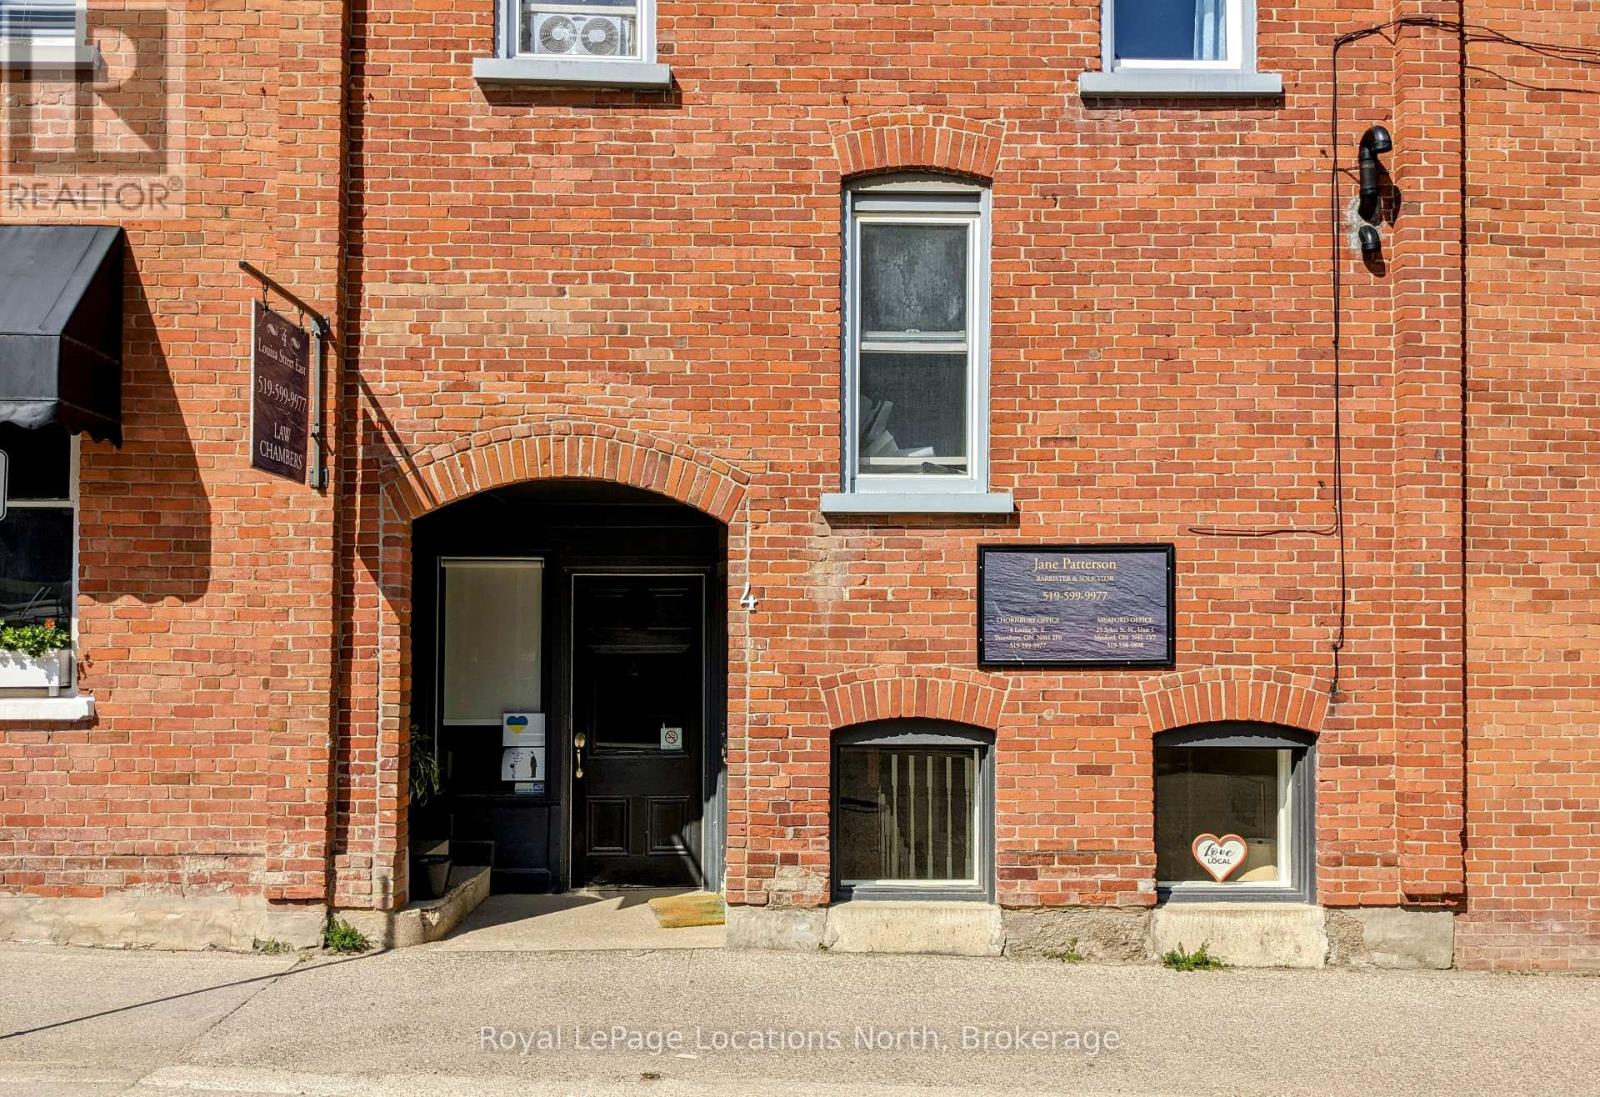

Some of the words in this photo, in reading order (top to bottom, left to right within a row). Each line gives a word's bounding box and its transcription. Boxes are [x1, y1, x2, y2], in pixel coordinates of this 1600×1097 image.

[281, 328, 288, 347] 4
[258, 337, 278, 361] Louisa
[278, 350, 295, 370] Street
[295, 359, 306, 376] East
[258, 375, 307, 413] 519-599-9977
[274, 422, 291, 442] LAW
[259, 440, 303, 470] CHAMBERS
[1033, 557, 1059, 572] Jane
[1063, 557, 1117, 570] Patterson
[740, 582, 757, 610] 4
[1042, 591, 1108, 601] 519-599-9977
[1204, 843, 1233, 857] Love
